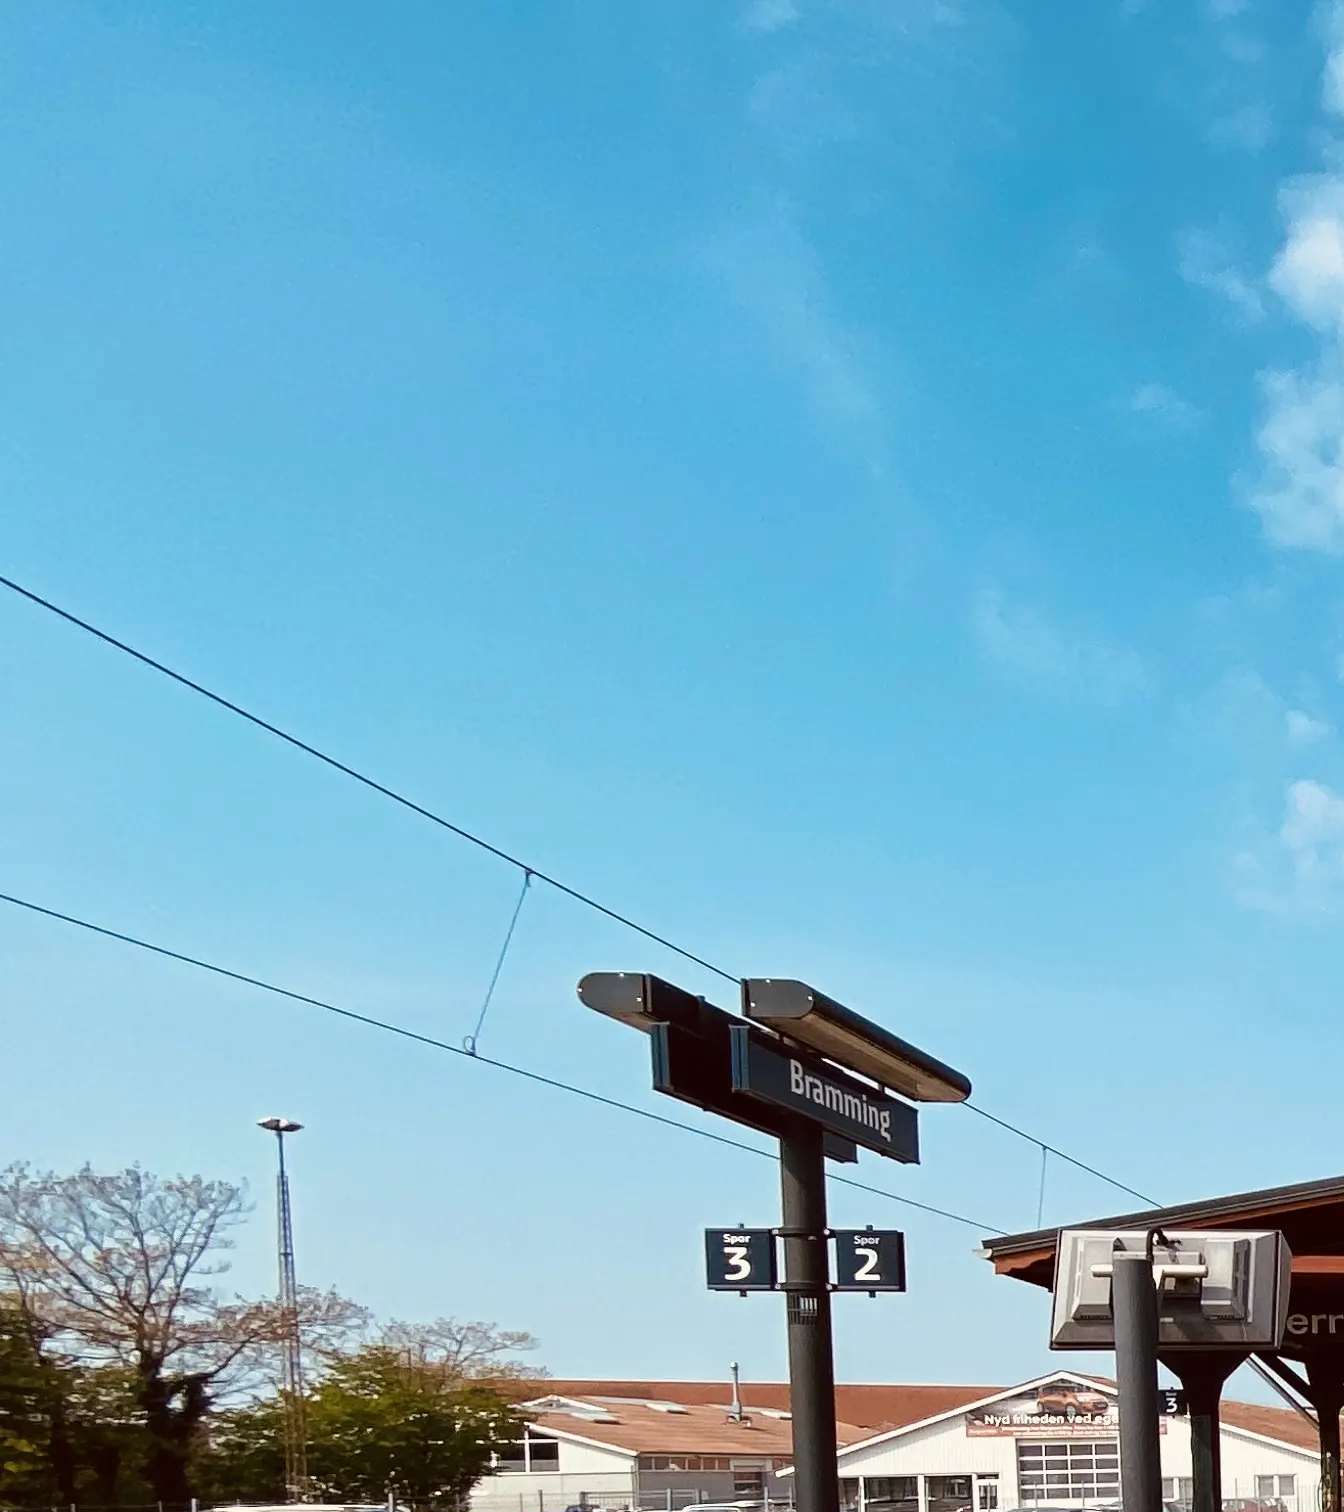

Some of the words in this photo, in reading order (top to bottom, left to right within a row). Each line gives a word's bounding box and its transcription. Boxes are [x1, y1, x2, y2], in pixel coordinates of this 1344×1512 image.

[790, 1058, 892, 1143] Bramming
[723, 1233, 751, 1245] Spor
[854, 1235, 880, 1246] Spor
[723, 1246, 751, 1281] 3
[854, 1248, 881, 1281] 2
[1165, 1397, 1178, 1413] 3
